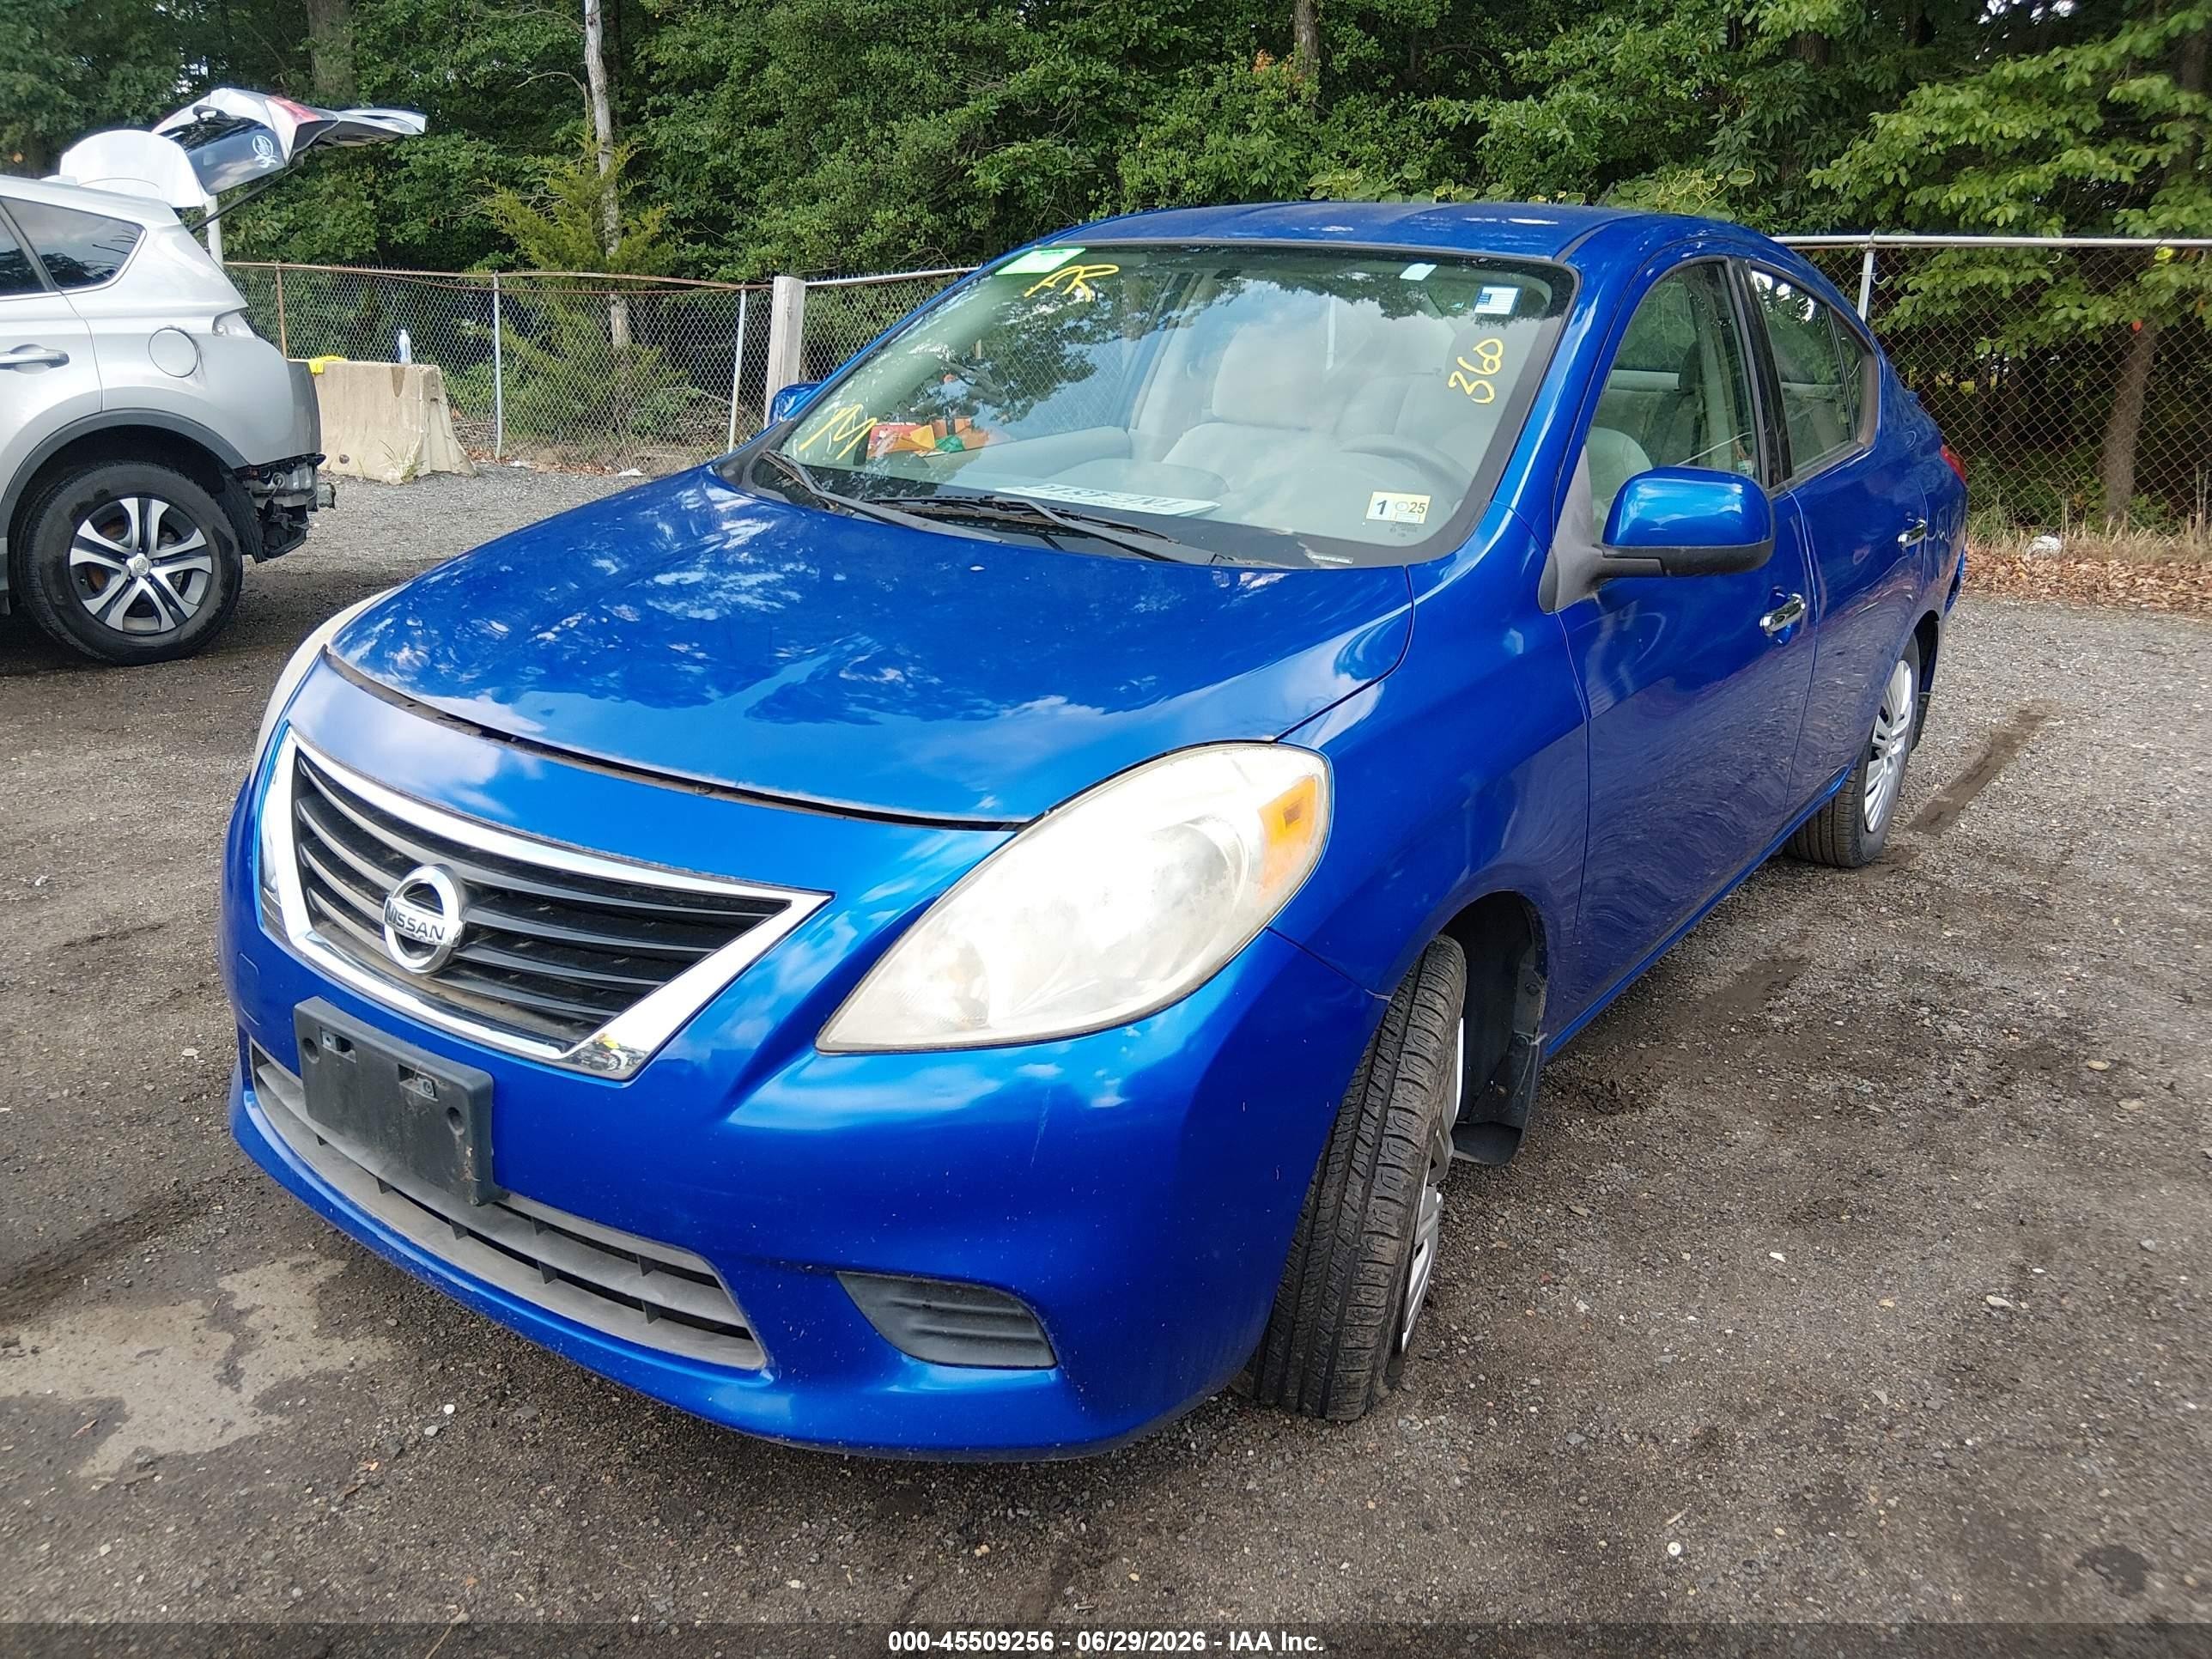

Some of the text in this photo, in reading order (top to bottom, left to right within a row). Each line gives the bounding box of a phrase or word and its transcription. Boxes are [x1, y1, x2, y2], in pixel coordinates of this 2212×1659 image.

[1376, 500, 1426, 515] 1 25
[384, 899, 446, 941] NISSAN
